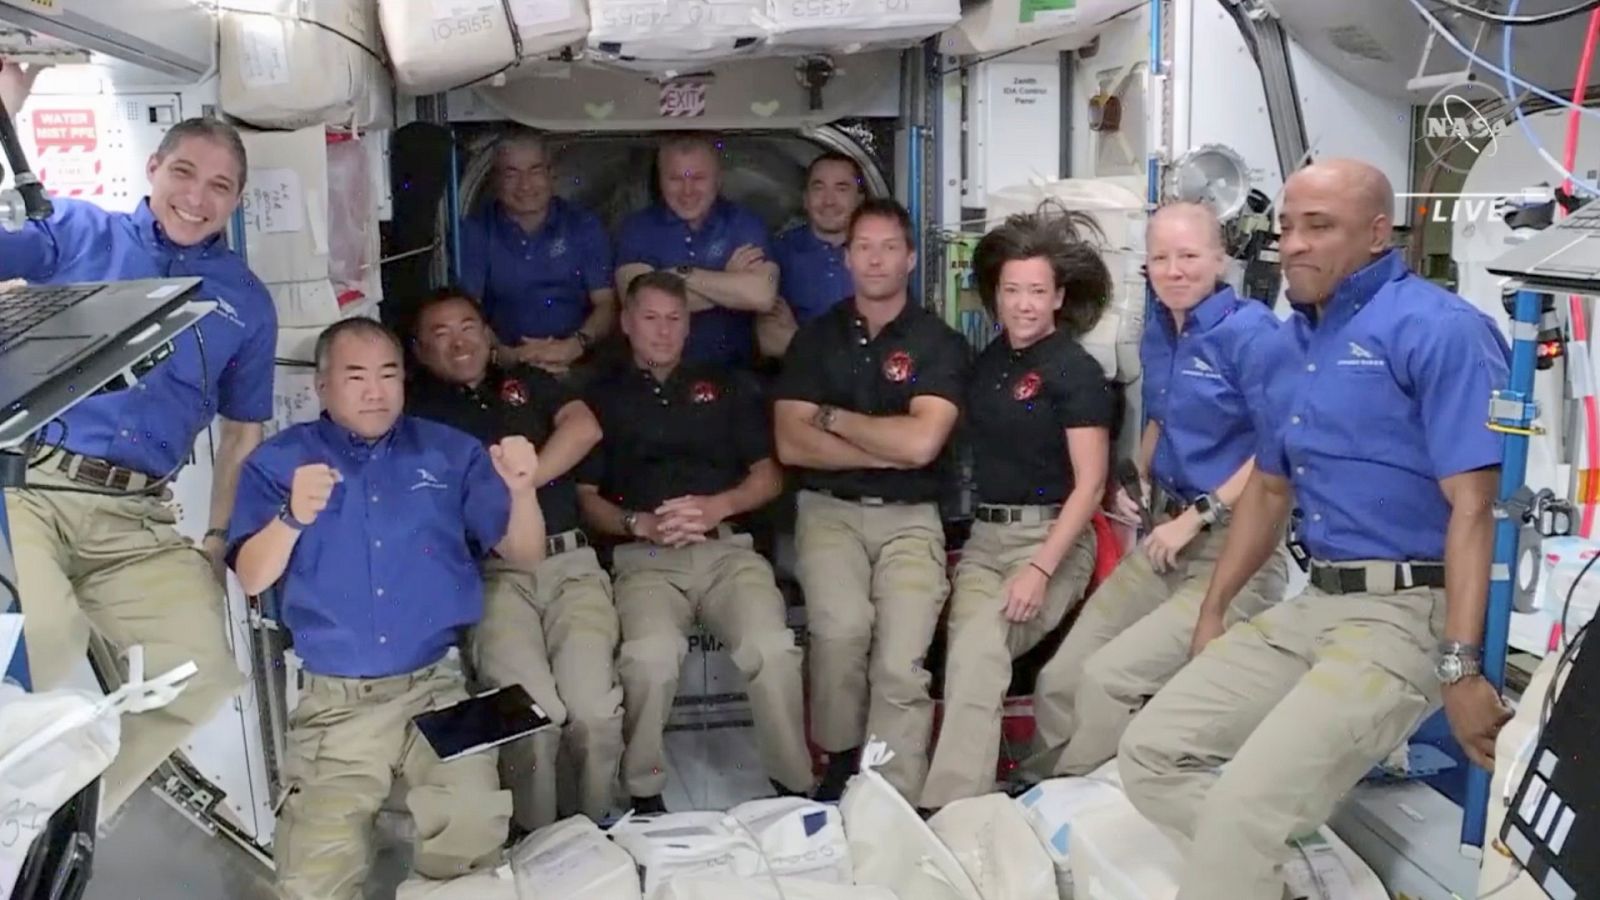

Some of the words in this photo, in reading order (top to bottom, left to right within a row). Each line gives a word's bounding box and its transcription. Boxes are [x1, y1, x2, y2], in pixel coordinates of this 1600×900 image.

[1003, 87, 1017, 95] IDA
[1019, 87, 1047, 95] Control
[667, 90, 699, 109] EXIT
[1014, 97, 1036, 105] Panel
[40, 112, 88, 126] WATER
[36, 127, 67, 139] MIST
